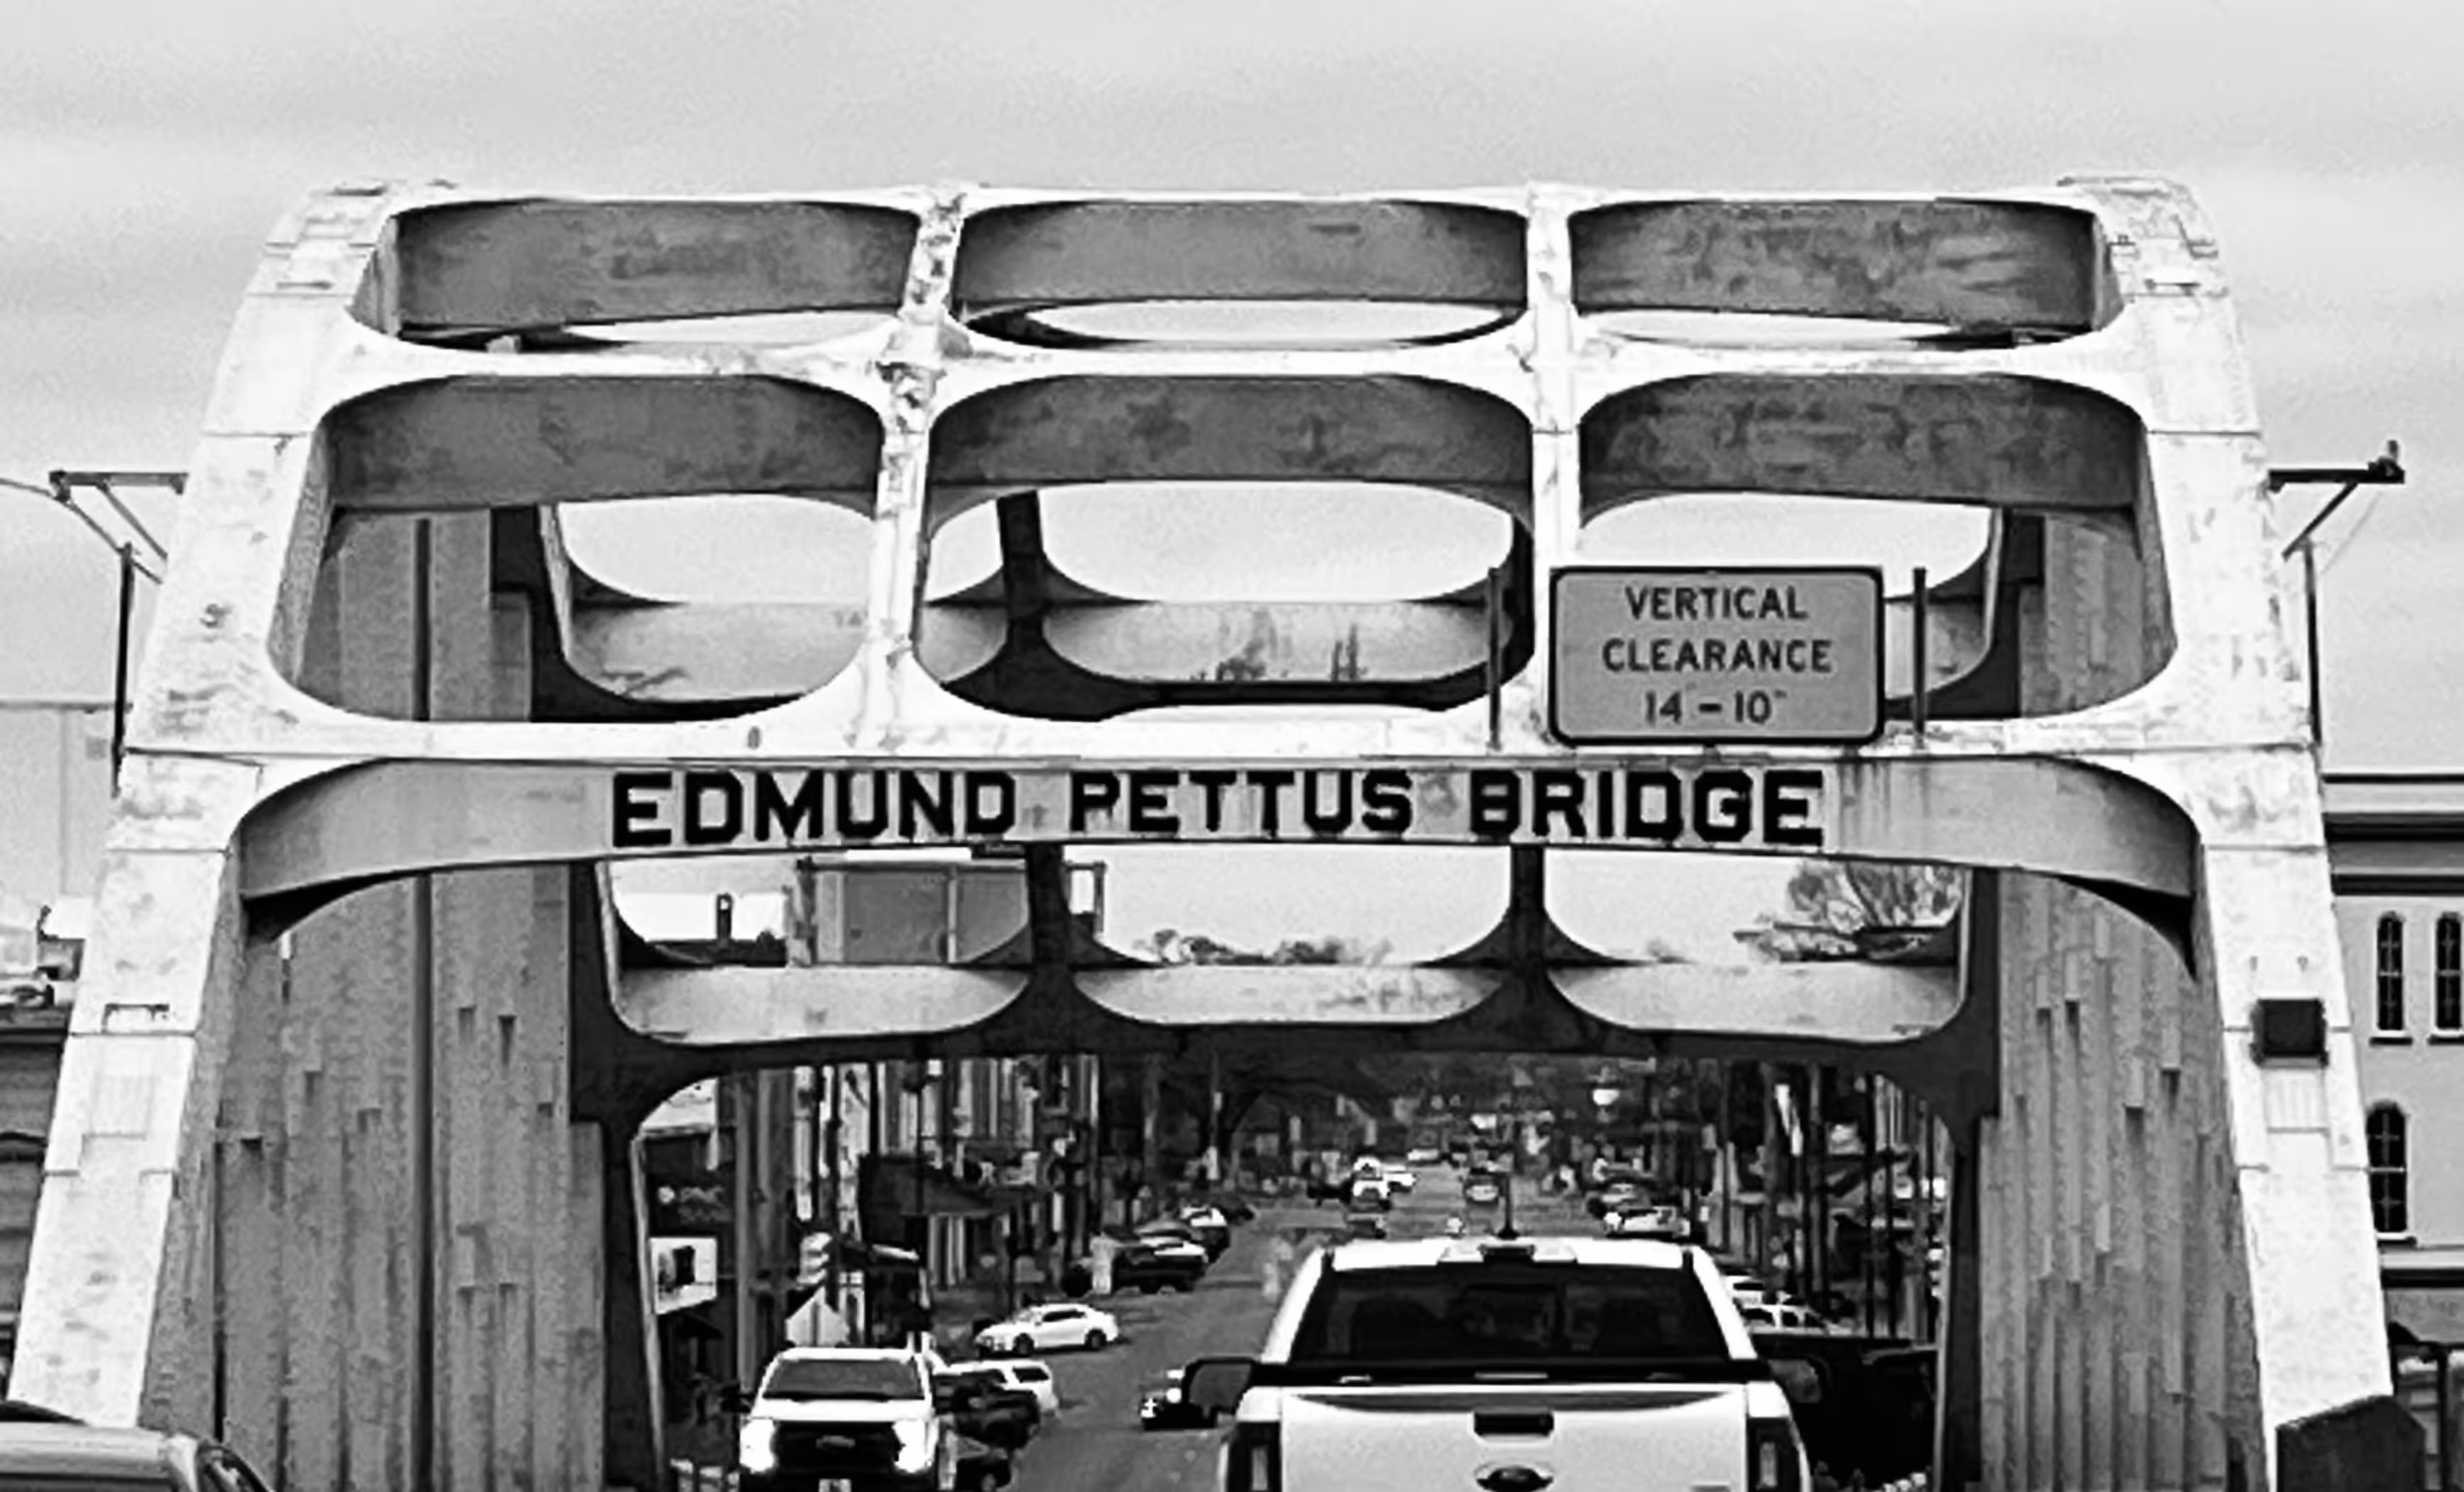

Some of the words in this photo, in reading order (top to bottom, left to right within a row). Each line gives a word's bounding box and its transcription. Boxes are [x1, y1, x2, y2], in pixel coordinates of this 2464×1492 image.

[1625, 585, 1810, 620] VERTICAL
[1601, 639, 1833, 673] CLEARANCE
[612, 770, 1016, 848] EDMUND
[1070, 769, 1413, 838] PETTUS
[1469, 769, 1823, 846] BRIDGE
